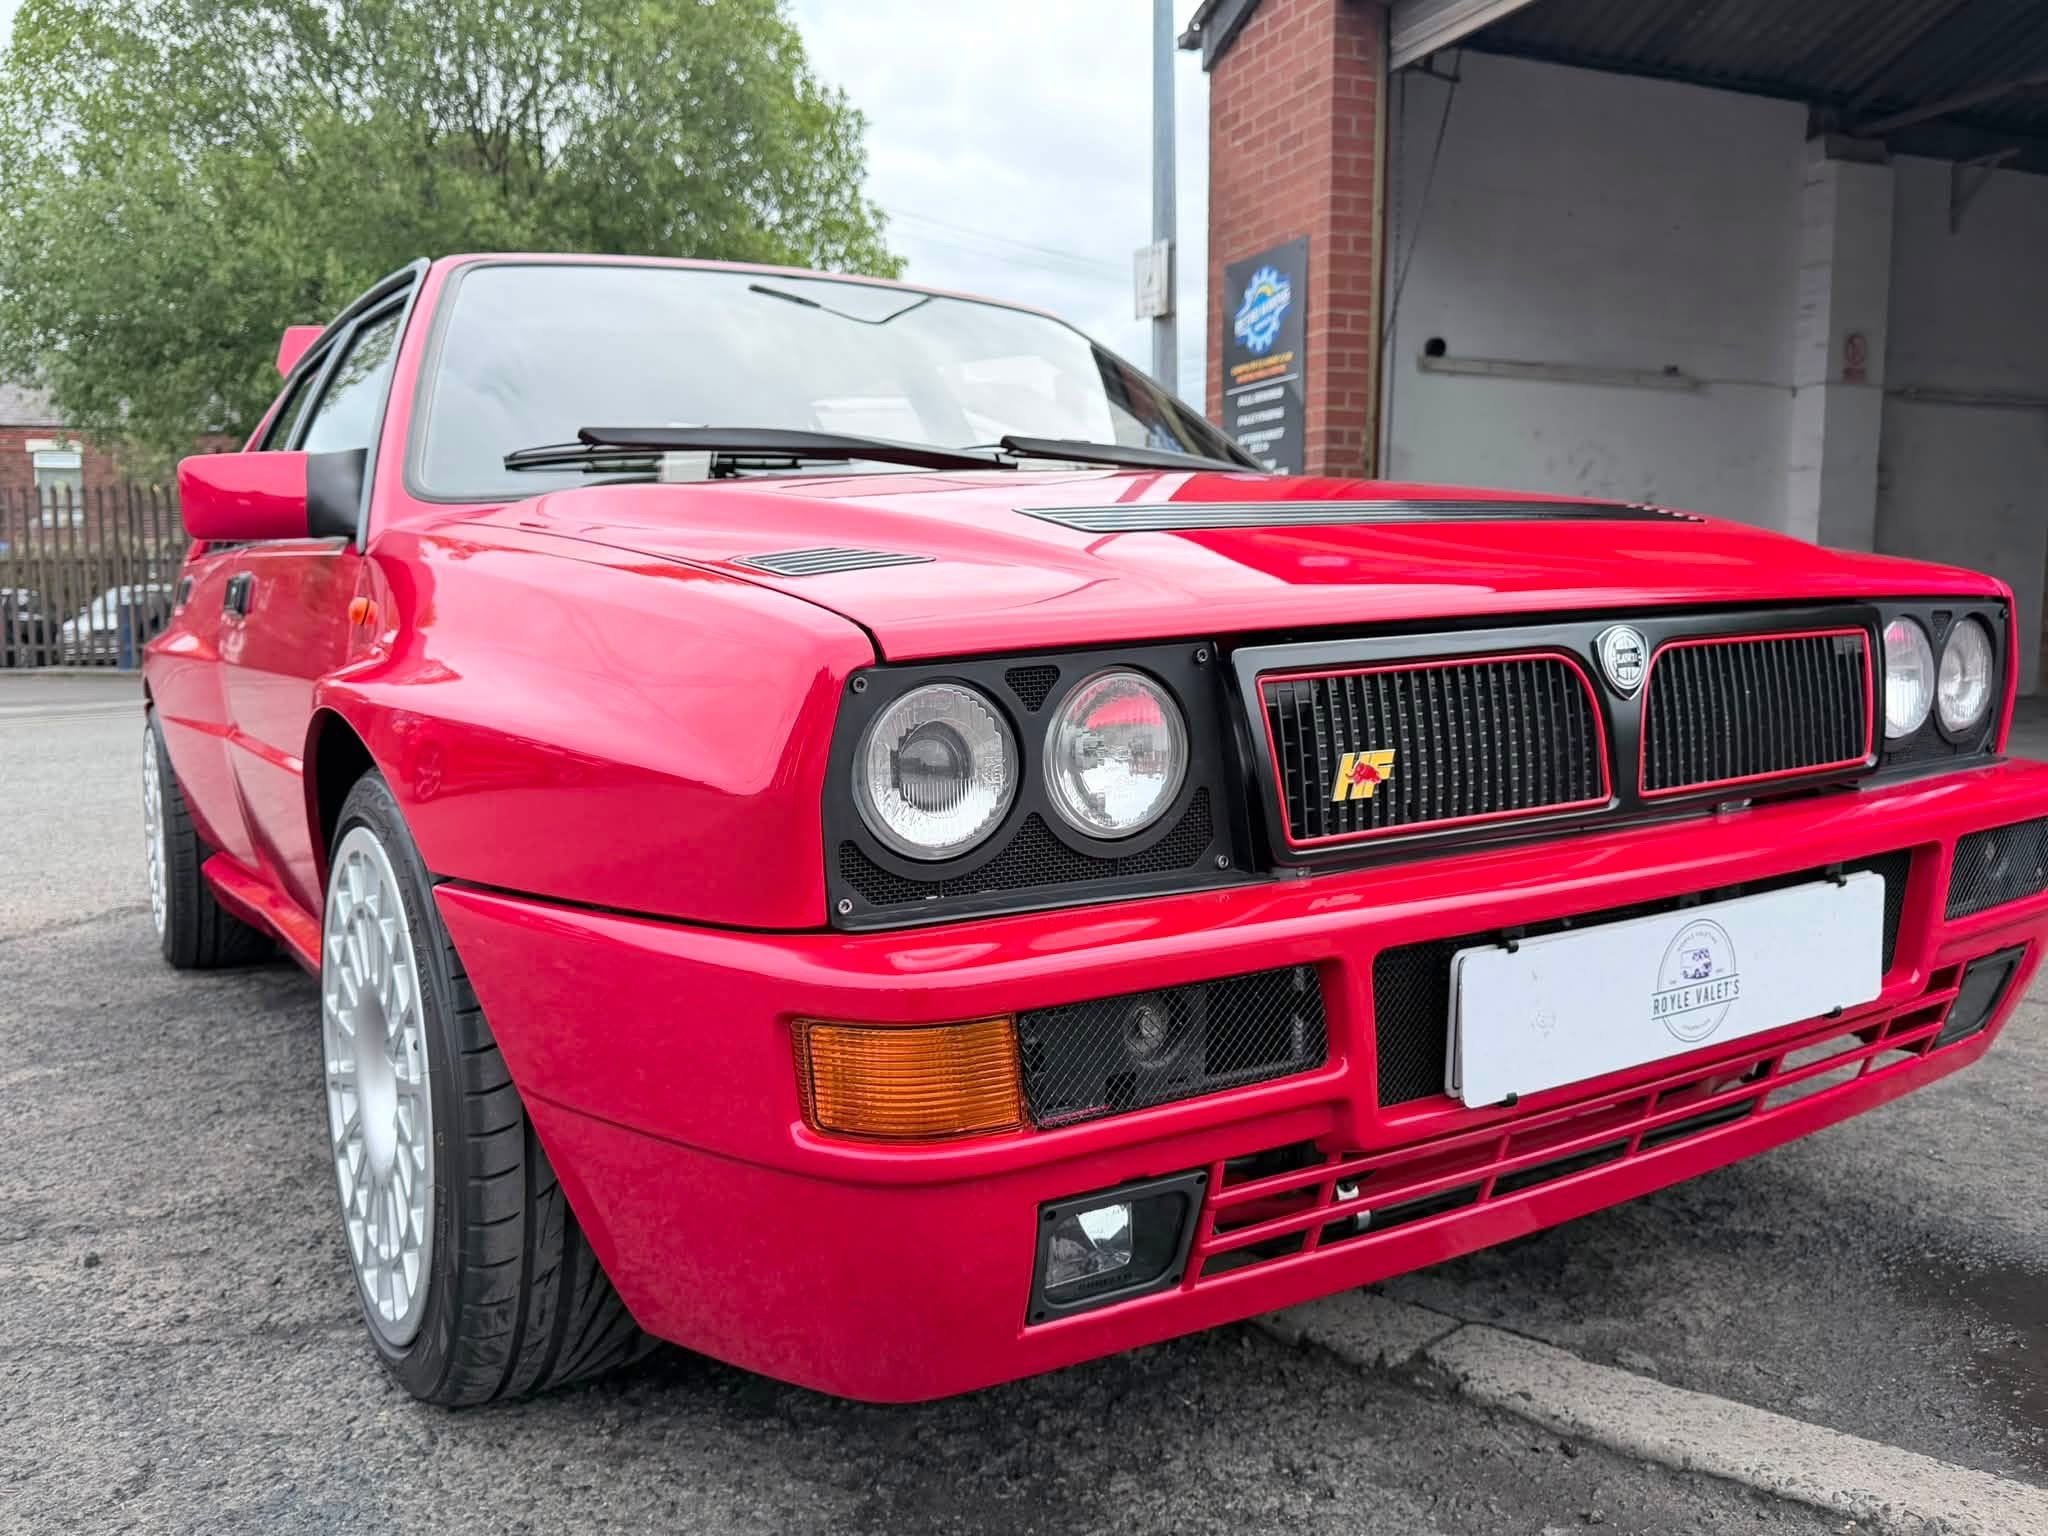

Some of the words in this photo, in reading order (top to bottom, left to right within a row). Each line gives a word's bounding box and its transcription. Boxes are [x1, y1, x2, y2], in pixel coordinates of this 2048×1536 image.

[1332, 749, 1396, 802] HF
[1653, 991, 1689, 1015] ROYLE
[1696, 979, 1740, 1004] VALET'S
